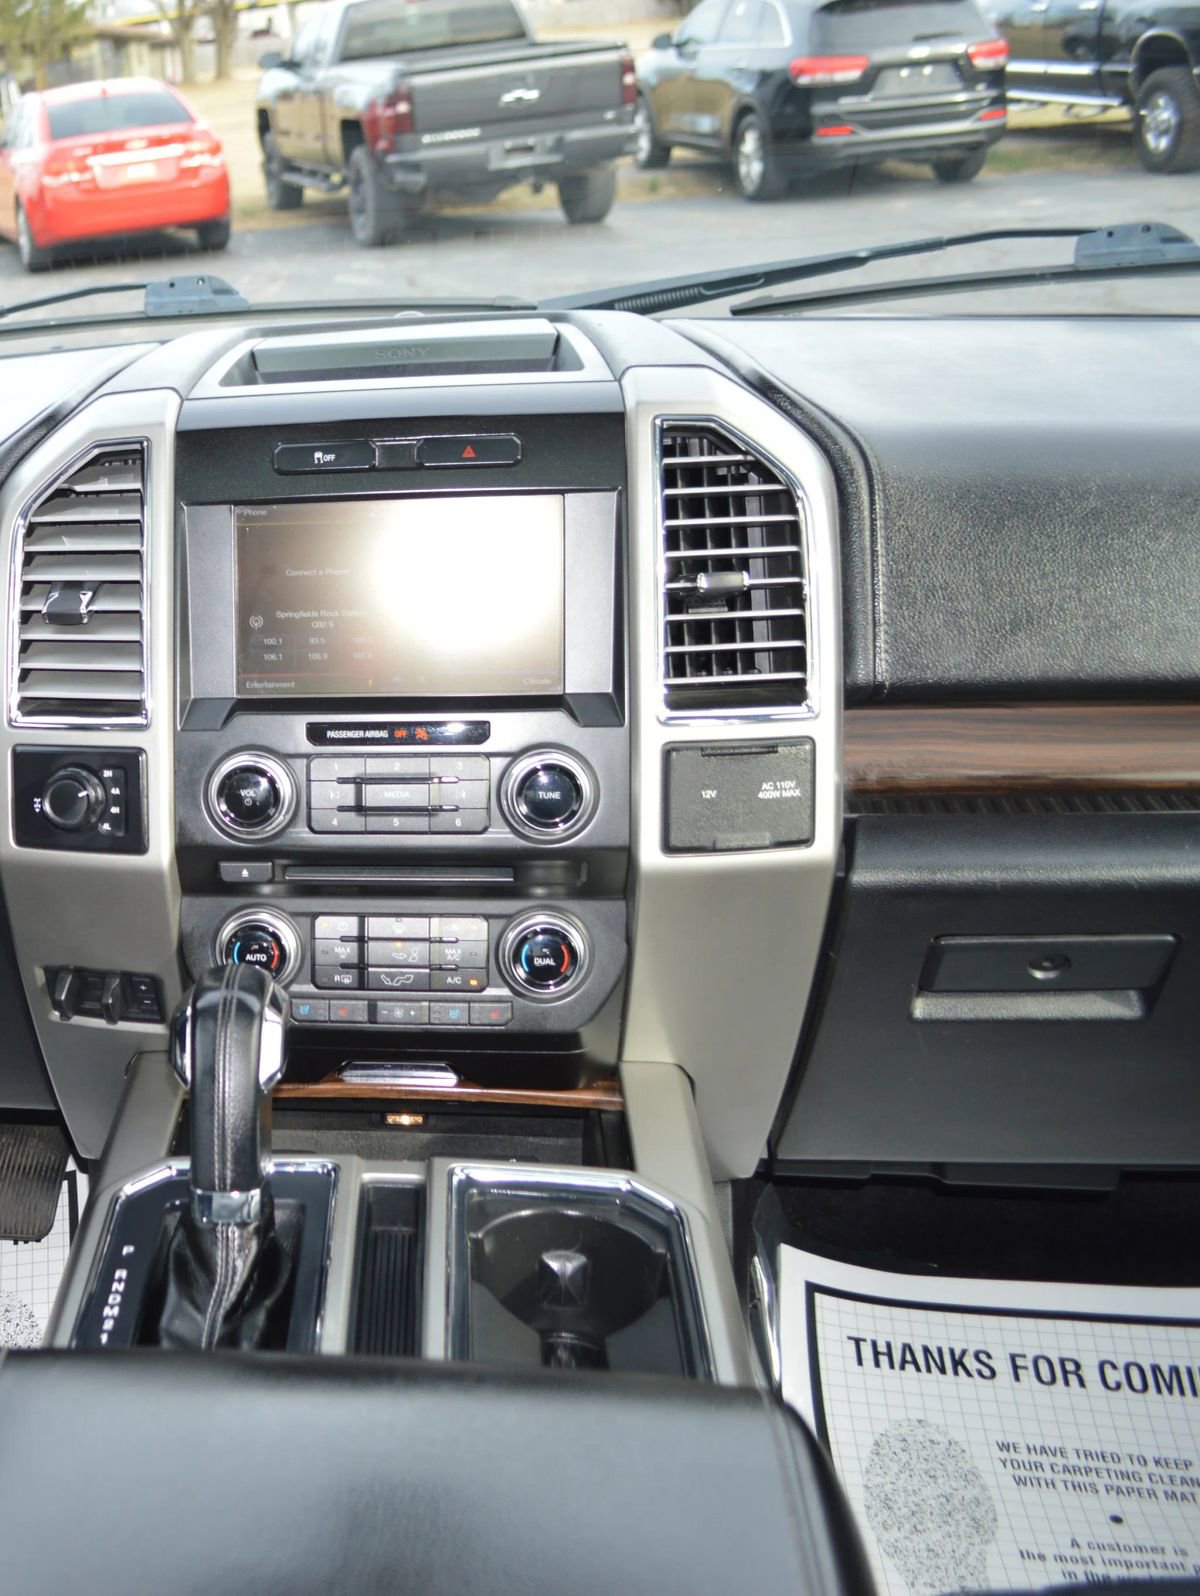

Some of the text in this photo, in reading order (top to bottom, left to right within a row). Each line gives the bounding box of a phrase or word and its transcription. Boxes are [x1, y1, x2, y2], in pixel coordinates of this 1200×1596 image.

[323, 454, 336, 462] OFF
[243, 508, 267, 517] Phone
[285, 568, 318, 577] Connect
[246, 681, 296, 689] Entertainment
[326, 729, 409, 738] PASSENGER AIRBAG OFF
[393, 762, 400, 771] 2
[761, 780, 796, 790] AC 110V
[111, 787, 120, 795] 4A
[240, 789, 256, 797] VOL
[383, 791, 411, 799] MEDIA
[538, 791, 562, 799] TUNE
[701, 790, 717, 799] 12V
[757, 788, 801, 799] 400W MAX
[331, 818, 338, 826] 4
[393, 818, 400, 827] 5
[455, 818, 462, 827] 6
[102, 823, 111, 831] 4L
[334, 946, 351, 954] MAX
[245, 953, 267, 962] AUTO
[533, 957, 556, 966] DUAL
[846, 1335, 1200, 1398] THANKS FOR COMI
[996, 1440, 1193, 1471] WE HAVE TRIED TO KEEP
[999, 1457, 1200, 1488] YOUR CARPETING CLEAN
[1012, 1474, 1197, 1504] WITH THIS PAPER MAT
[1070, 1537, 1189, 1557] A customer is
[1019, 1549, 1047, 1562] the
[1053, 1554, 1095, 1566] most
[1100, 1555, 1186, 1571] important
[1061, 1568, 1079, 1581] in
